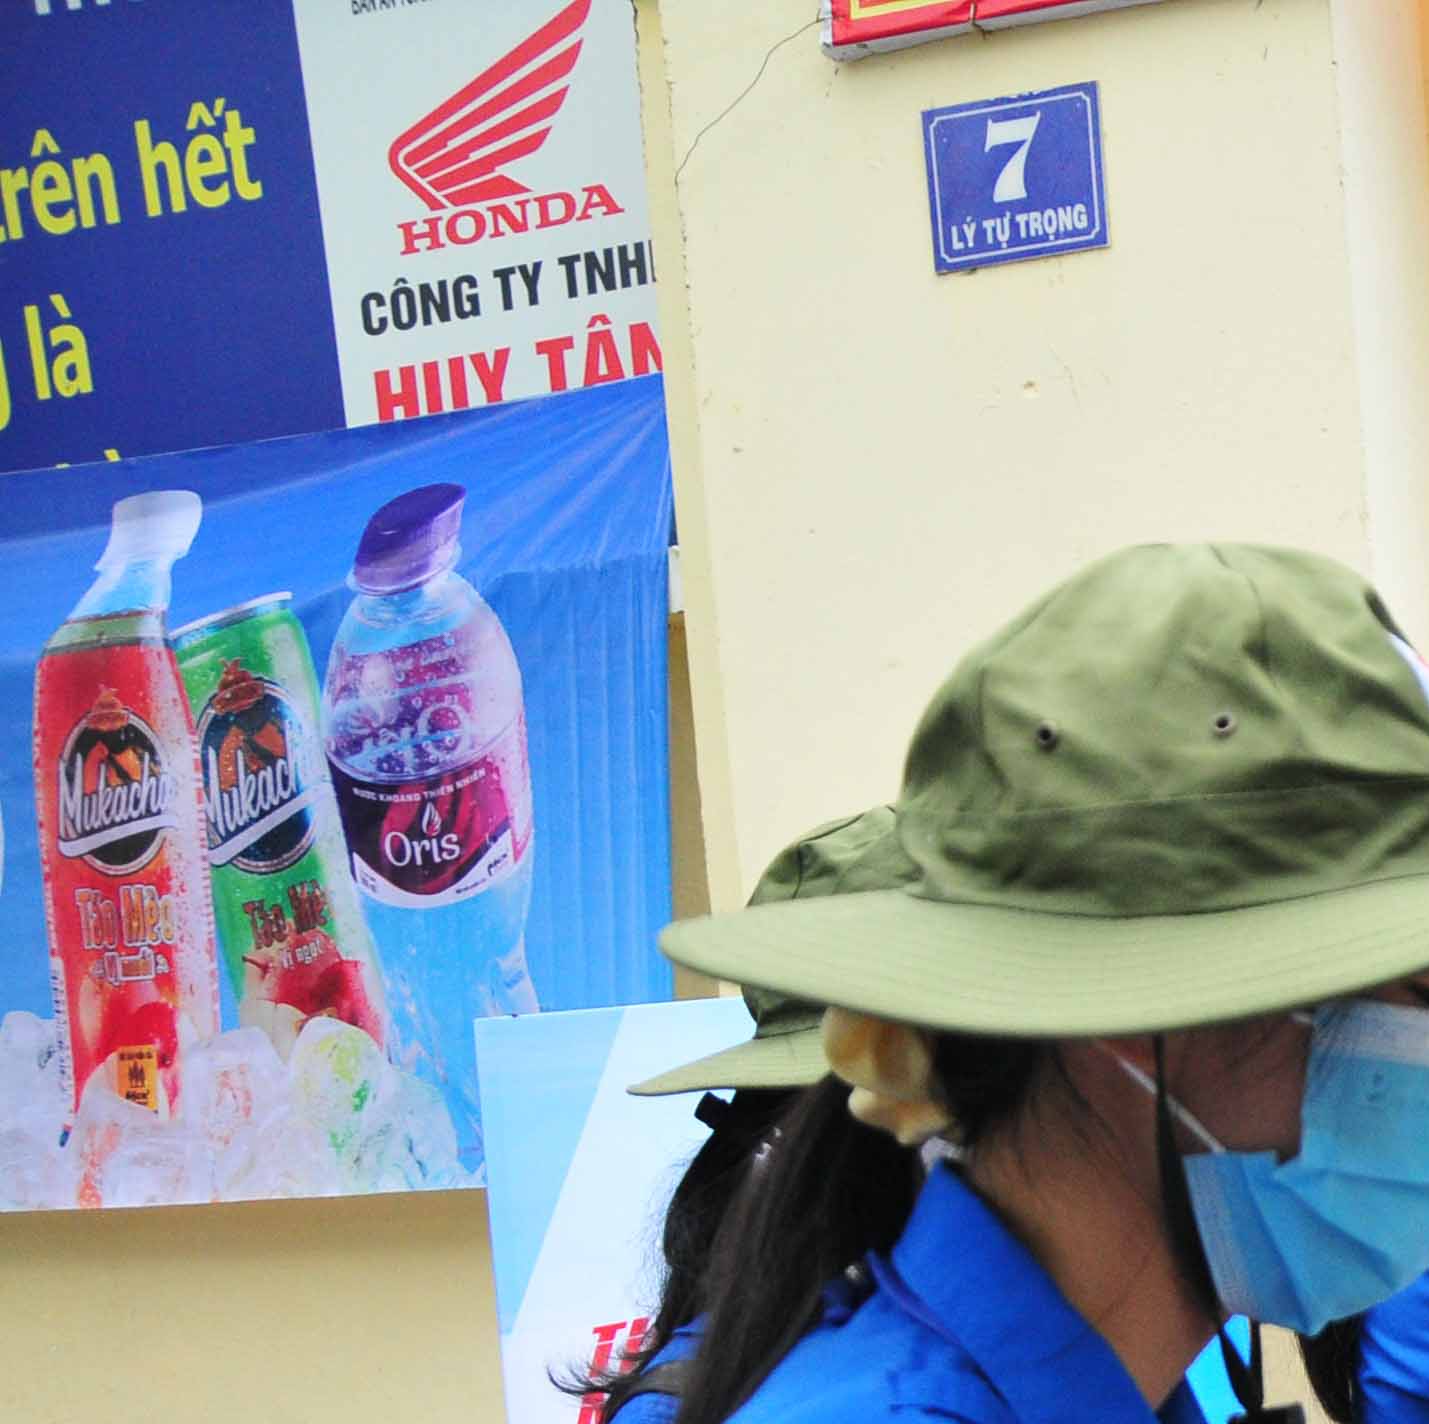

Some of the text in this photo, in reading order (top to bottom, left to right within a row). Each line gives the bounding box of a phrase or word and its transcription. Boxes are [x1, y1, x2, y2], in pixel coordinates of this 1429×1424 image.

[0, 97, 263, 243] rên hết
[984, 110, 1041, 203] 7
[396, 183, 625, 256] HONDA
[951, 203, 1088, 250] LÝ TỰ TRỌNG
[361, 239, 657, 336] CÔNG TY TNH
[24, 293, 94, 400] là
[384, 830, 461, 867] Oris
